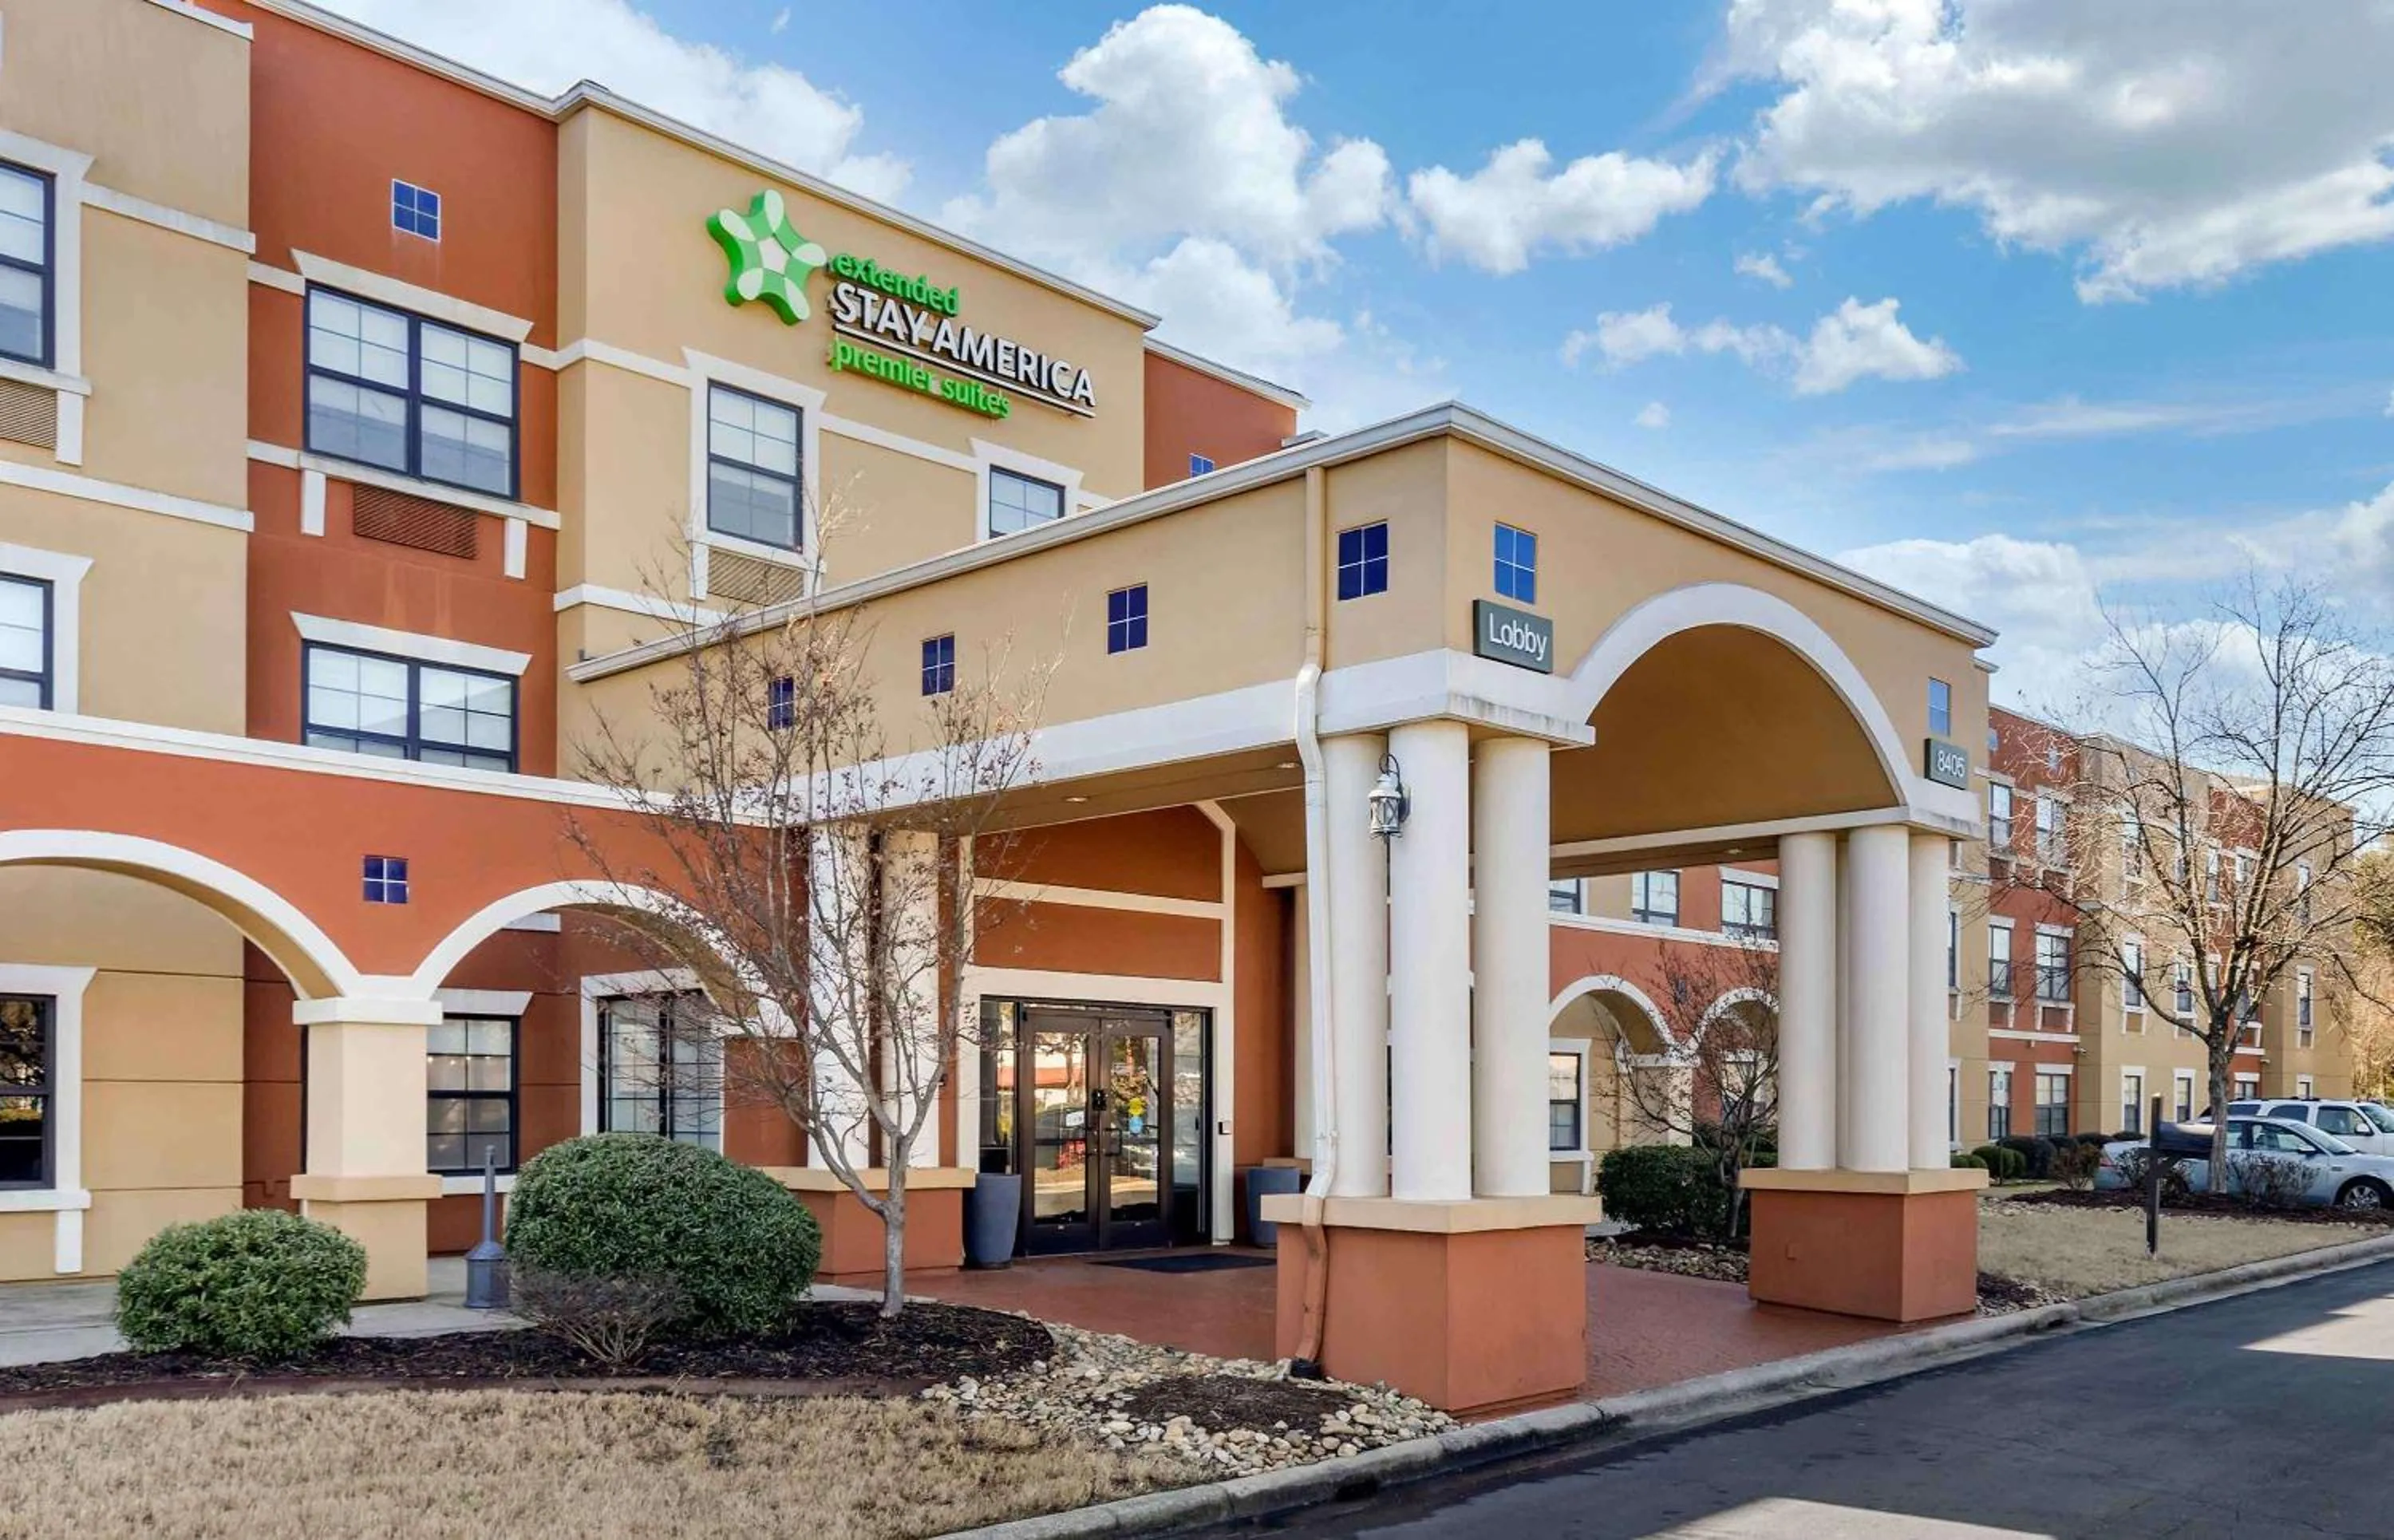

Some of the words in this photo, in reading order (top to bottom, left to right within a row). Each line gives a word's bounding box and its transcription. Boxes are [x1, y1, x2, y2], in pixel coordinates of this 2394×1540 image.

[834, 254, 959, 315] extended
[834, 282, 929, 346] STAY
[931, 319, 1096, 407] AMERICA
[833, 340, 933, 390] premier
[941, 377, 1011, 418] suites
[1489, 612, 1548, 661] Lobby
[1937, 750, 1965, 778] 8405
